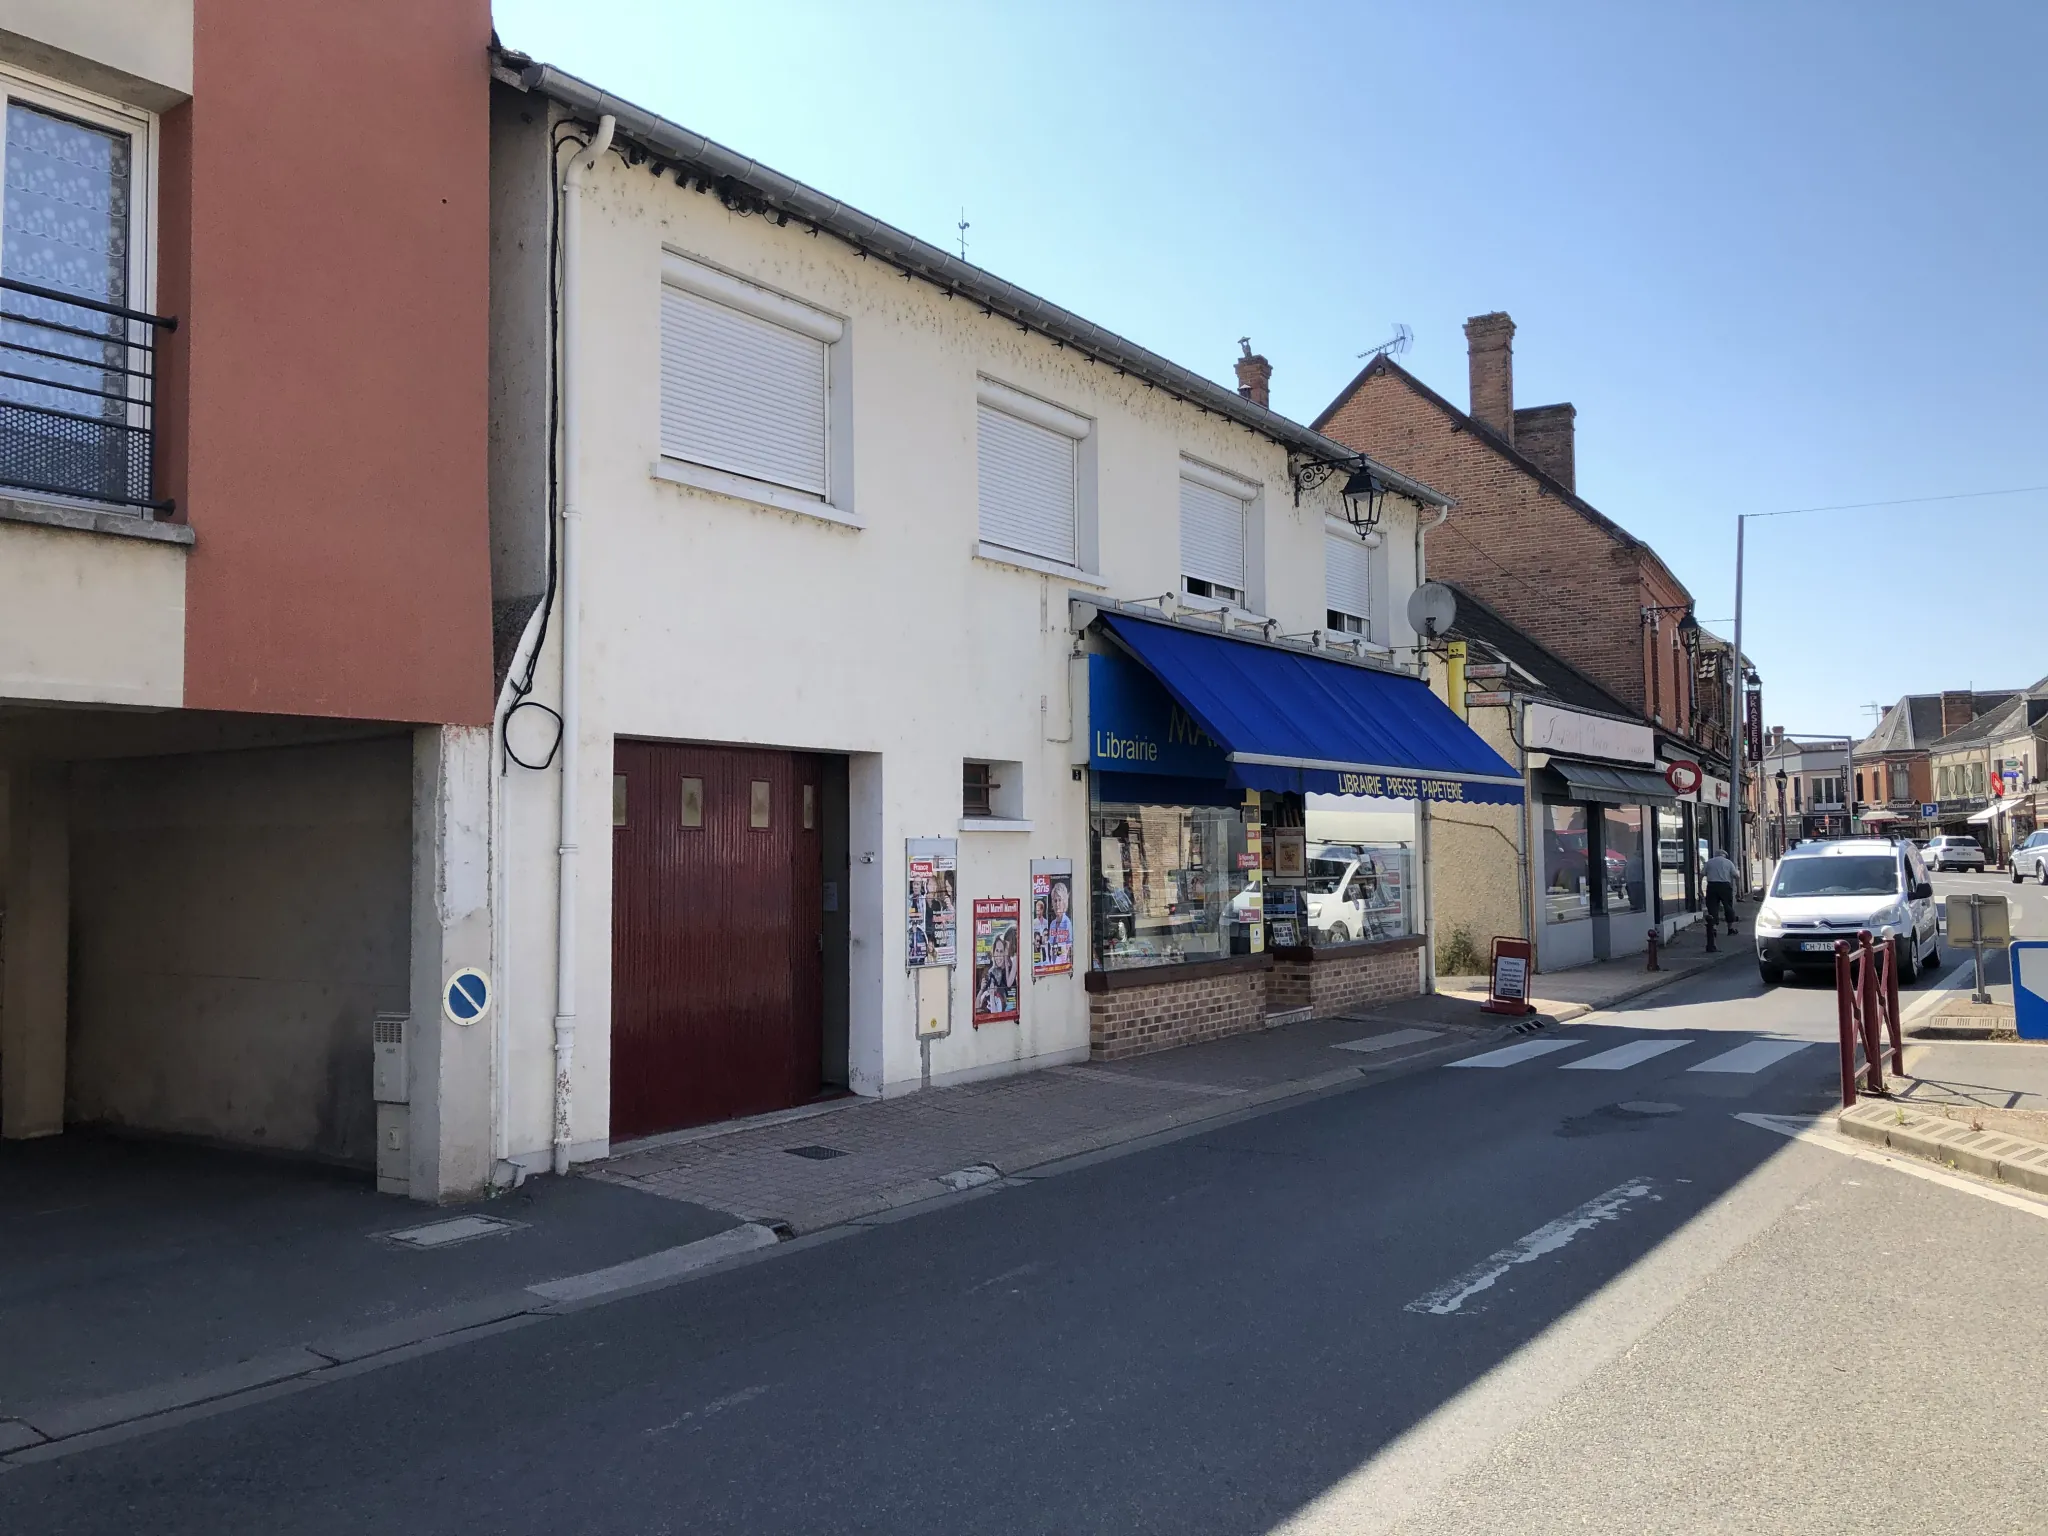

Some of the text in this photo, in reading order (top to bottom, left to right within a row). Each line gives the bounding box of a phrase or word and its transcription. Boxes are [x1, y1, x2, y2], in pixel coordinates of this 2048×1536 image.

[1096, 730, 1158, 762] Librairie
[1338, 773, 1464, 800] LIBRAIRIE PRESSE PAPETERIE
[1925, 805, 1934, 816] P
